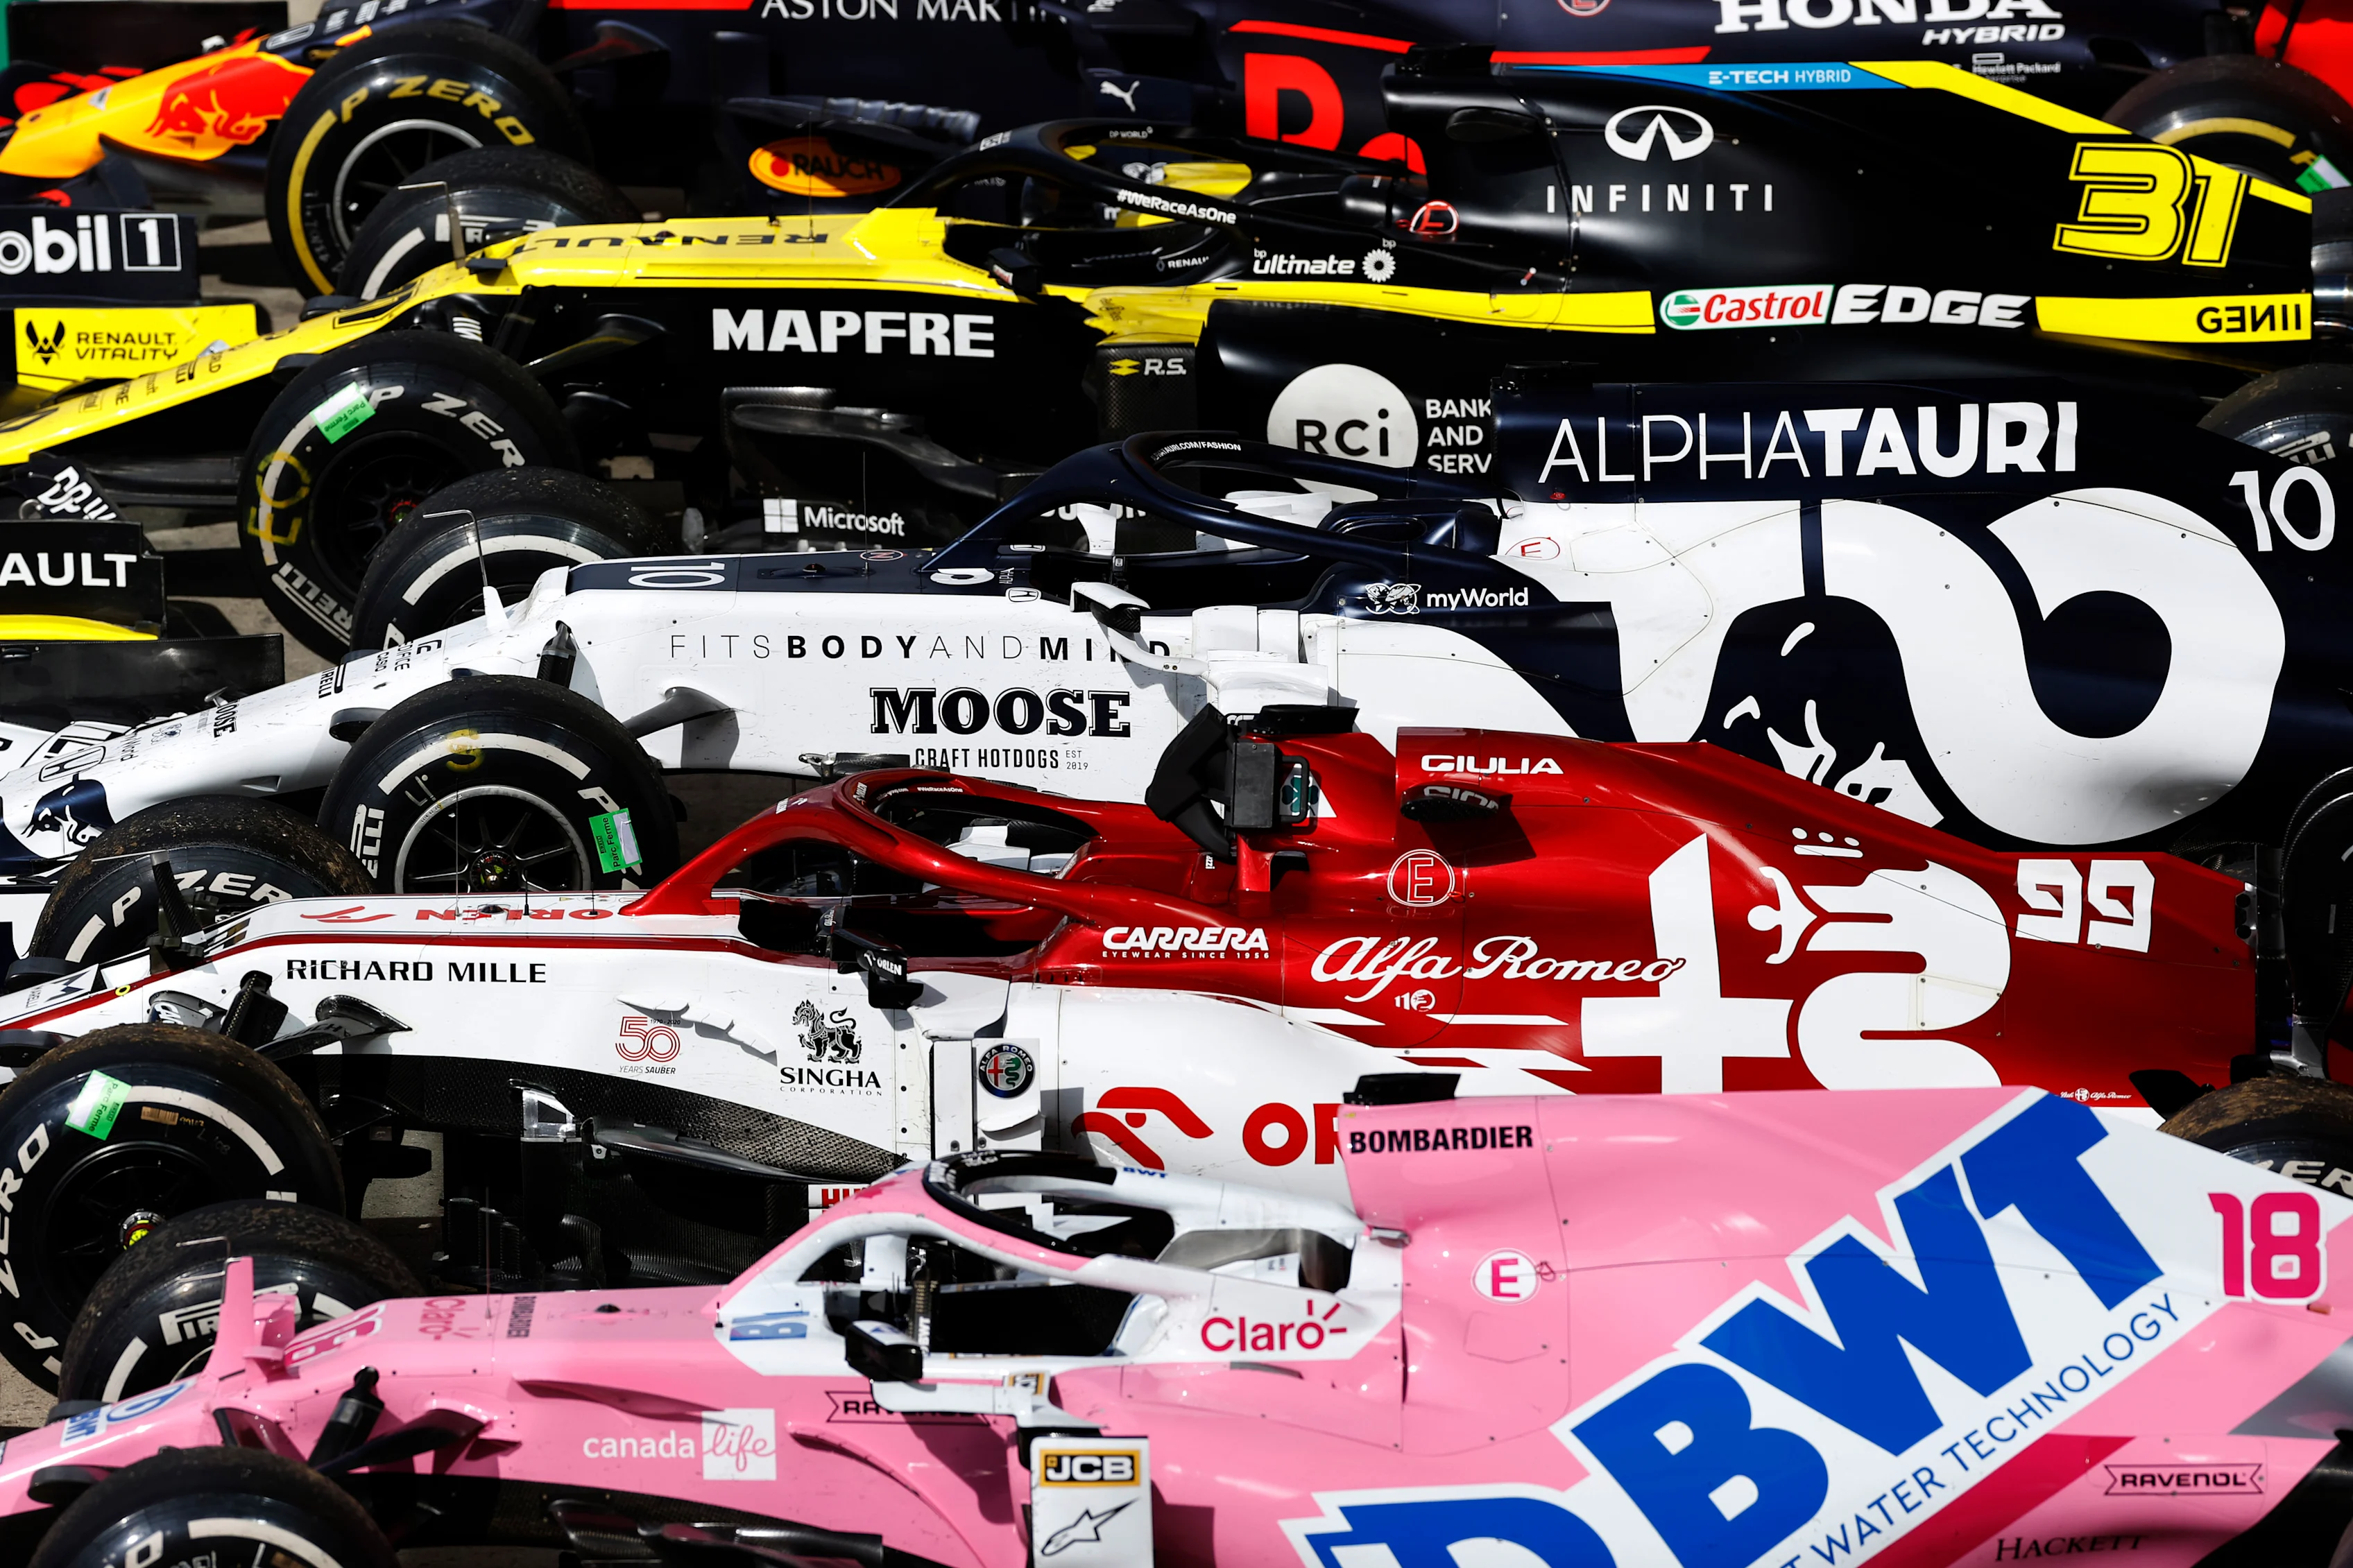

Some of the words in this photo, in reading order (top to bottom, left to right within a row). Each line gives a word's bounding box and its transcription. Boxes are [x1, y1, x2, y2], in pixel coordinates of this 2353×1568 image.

[1714, 0, 2063, 33] HONDA
[1923, 24, 2065, 46] HYBRID
[1709, 70, 1788, 84] E-TECH
[1795, 70, 1851, 83] HYBRID
[341, 87, 369, 123] P
[388, 75, 536, 146] ZERO
[794, 153, 886, 181] RAUCH
[1117, 189, 1237, 225] #WeRaceAsOne
[1547, 184, 1774, 214] INFINITI
[2053, 142, 2248, 267] 31
[1253, 248, 1267, 258] bp
[1383, 238, 1396, 250] bp
[1253, 255, 1355, 275] ultimate
[1704, 291, 1823, 323] Castrol
[1831, 284, 2033, 328] EDGE
[77, 331, 176, 345] RENAULT
[712, 309, 995, 358] MAPFRE
[76, 347, 178, 360] VITALITY
[1144, 358, 1188, 376] R.S.
[1426, 398, 1491, 419] BANK
[369, 386, 404, 410] P
[422, 392, 525, 467] ZER
[1296, 407, 1390, 458] RCi
[1427, 424, 1484, 447] AND
[1538, 401, 2077, 483] ALPHATAURI
[804, 506, 905, 537] Microsoft
[2228, 465, 2336, 552] 10
[1426, 587, 1529, 612] myWorld
[375, 652, 389, 672] CASIO
[870, 687, 1131, 737] MOOSE
[915, 748, 970, 768] CRAFT
[978, 748, 1059, 769] HOTDOGS
[1066, 750, 1082, 758] EST
[1066, 762, 1088, 770] 2019
[1421, 755, 1564, 775] GIULIA
[602, 816, 615, 842] Ferme
[612, 843, 621, 868] Parc
[1407, 857, 1434, 903] E
[112, 886, 142, 927] P
[173, 869, 294, 904] ZER
[2015, 858, 2156, 954] 99
[1102, 927, 1269, 951] CARRERA
[286, 959, 434, 981] RICHARD
[448, 963, 547, 983] MILLE
[876, 959, 902, 976] ORLEN
[1310, 936, 1464, 1003] Alfa
[1462, 936, 1686, 982] Romeo
[615, 1015, 681, 1062] 50
[619, 1065, 644, 1074] YEARS
[644, 1065, 676, 1075] SAUBER
[979, 1048, 998, 1072] ALFA
[1002, 1044, 1033, 1072] ROMEO
[779, 1086, 883, 1096] CORPORATION
[780, 1067, 882, 1089] SINGHA
[88, 1104, 108, 1132] Ferme
[1349, 1125, 1534, 1155] BOMBARDIER
[1123, 1166, 1168, 1178] BWT
[2207, 1191, 2321, 1298] 18
[1490, 1258, 1521, 1298] E
[13, 1322, 59, 1350] P
[1201, 1315, 1325, 1352] Claro
[1569, 1089, 2166, 1568] BWT
[583, 1431, 695, 1459] canada
[705, 1411, 776, 1472] life
[1810, 1465, 1946, 1566] WATER
[1940, 1292, 2180, 1472] TECHNOLOGY
[1045, 1456, 1134, 1482] JCB
[2120, 1472, 2247, 1488] RAVENOL
[1994, 1533, 2150, 1562] HACKETT
